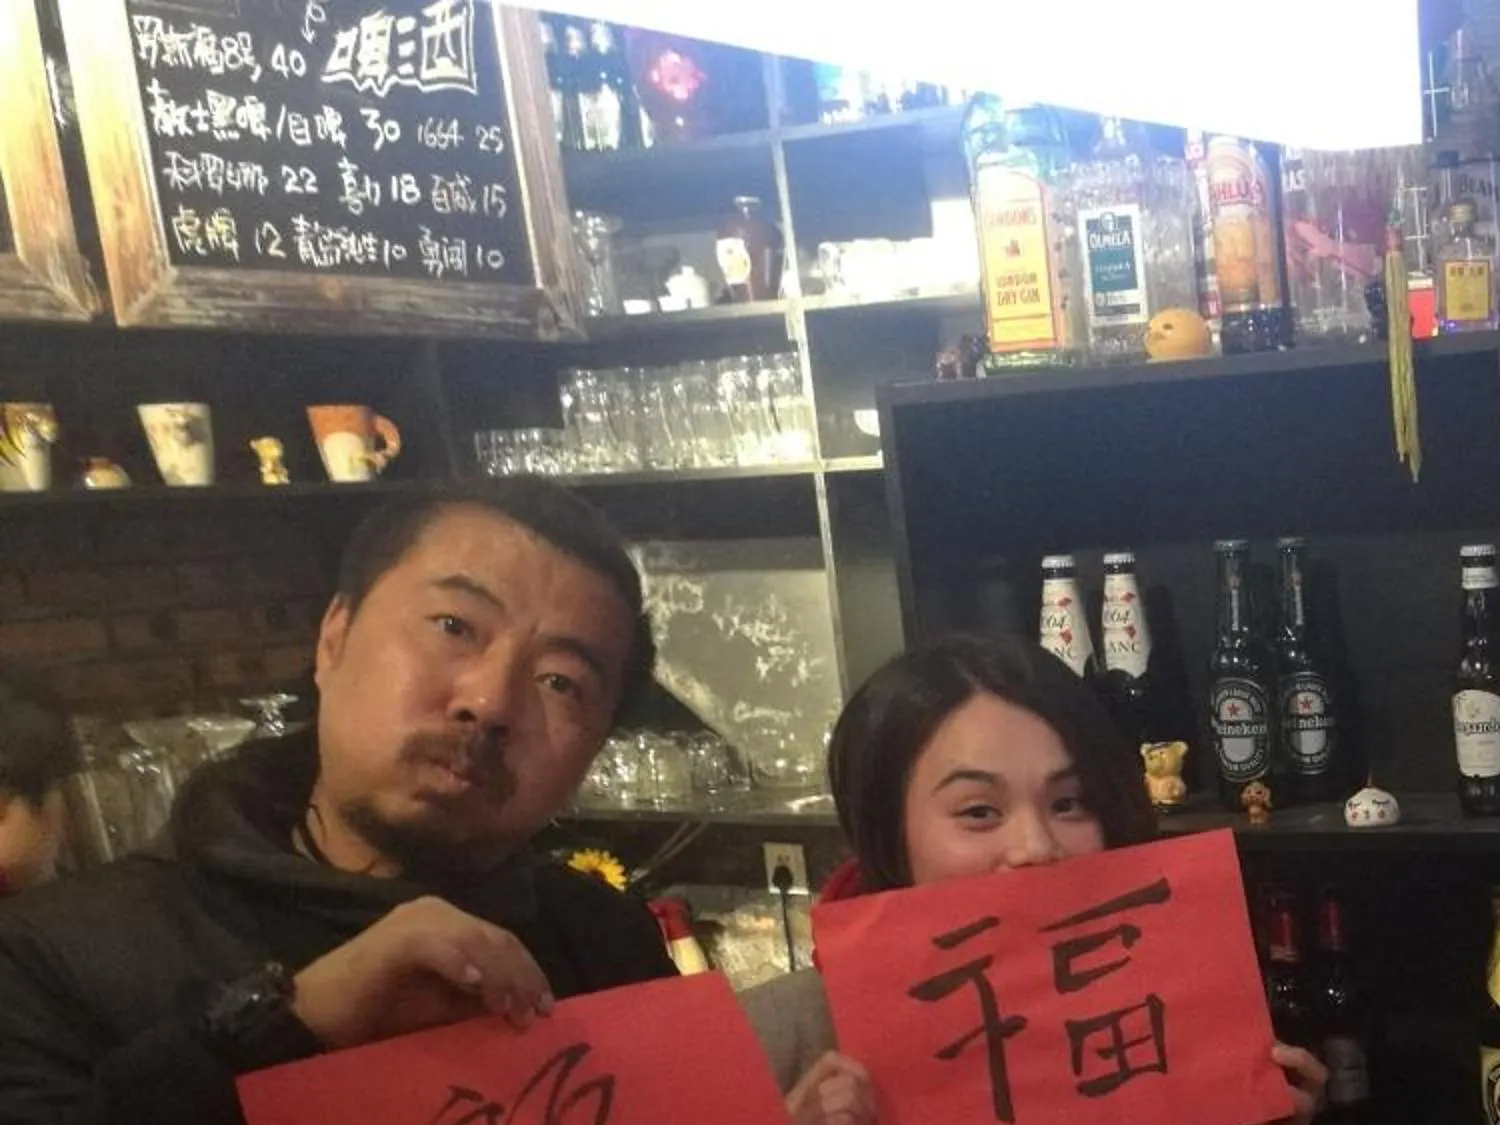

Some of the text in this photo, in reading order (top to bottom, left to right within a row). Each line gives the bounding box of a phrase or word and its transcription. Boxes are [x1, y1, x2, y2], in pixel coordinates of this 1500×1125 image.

[271, 43, 307, 79] 40
[322, 0, 473, 86] 啤酒
[360, 107, 401, 151] 30
[417, 116, 465, 150] 1664
[476, 124, 504, 154] 25
[281, 164, 319, 194] 22
[391, 174, 421, 204] 18
[483, 184, 508, 218] 15
[255, 221, 287, 259] 12
[383, 238, 407, 269] 10
[476, 243, 505, 270] 10
